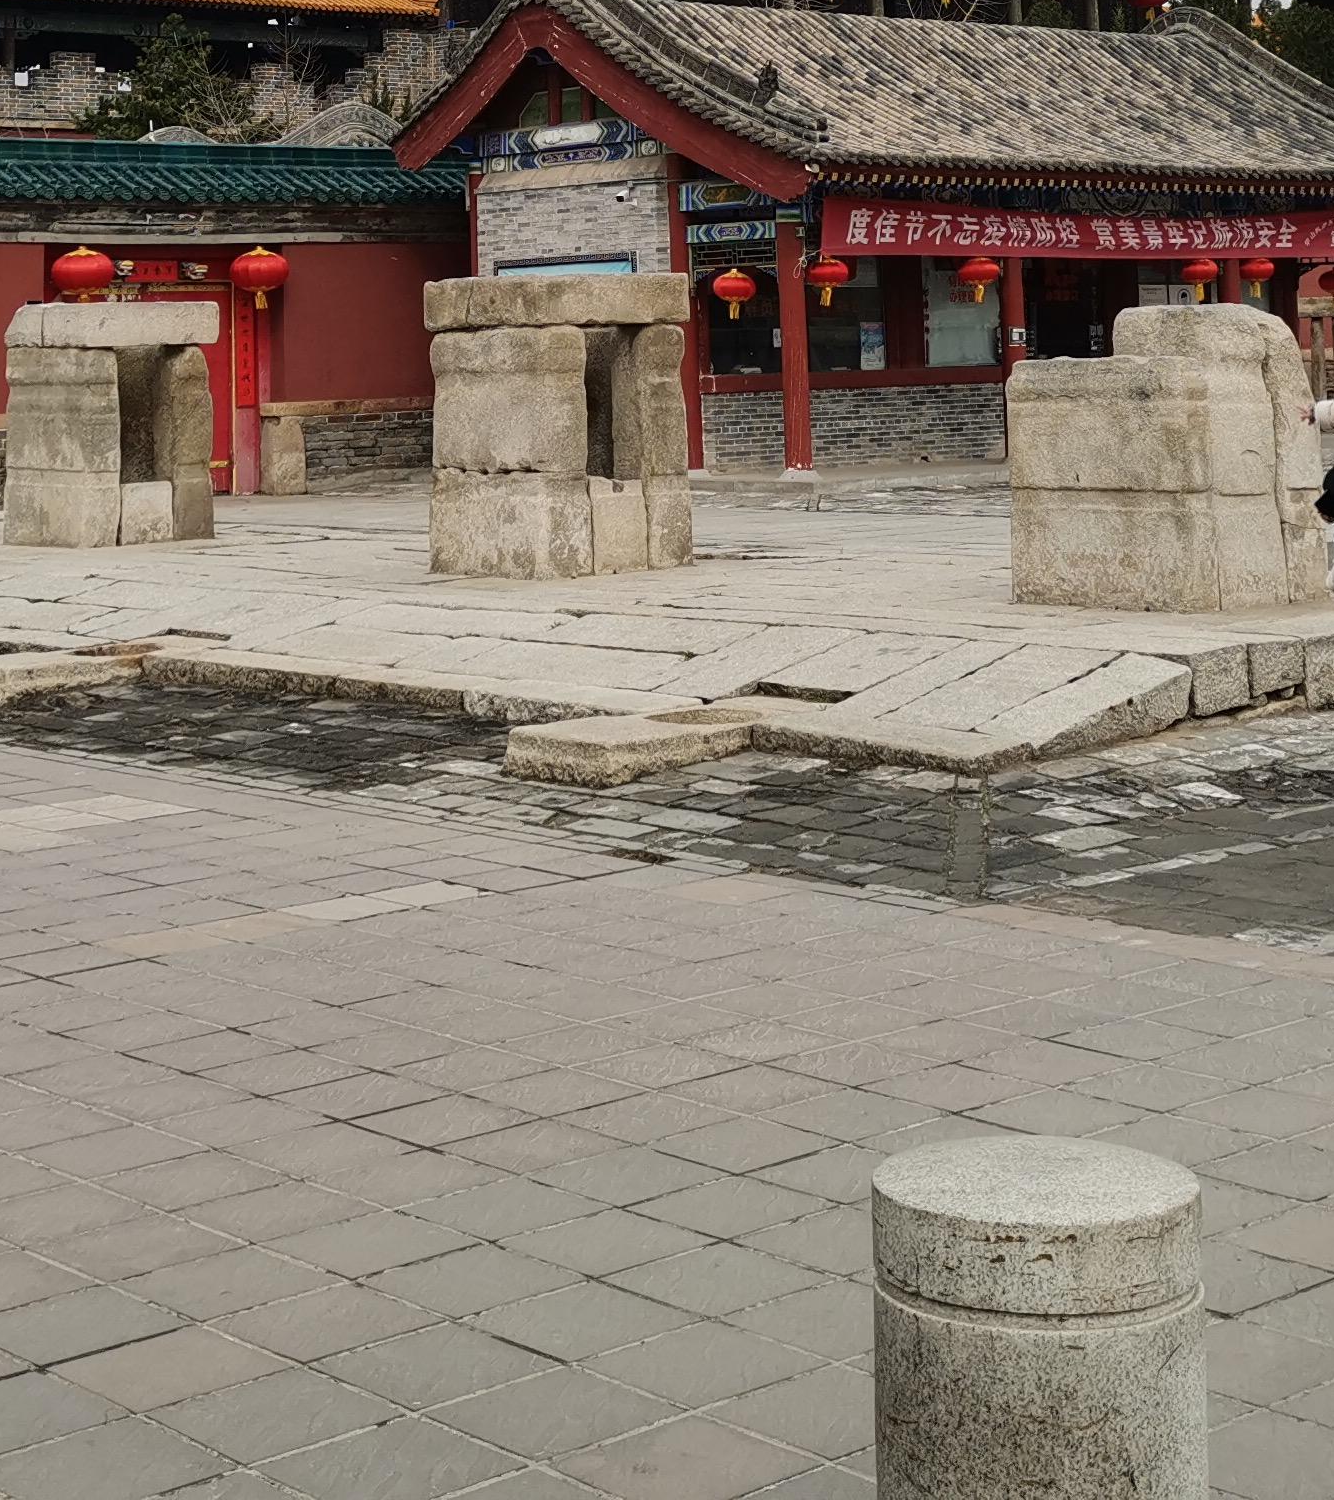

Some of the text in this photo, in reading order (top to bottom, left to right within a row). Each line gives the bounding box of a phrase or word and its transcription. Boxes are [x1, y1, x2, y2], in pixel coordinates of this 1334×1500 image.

[845, 207, 1081, 249] 度佳节不忘疫情防控
[1089, 217, 1298, 251] 赏美景牢记旅游安全
